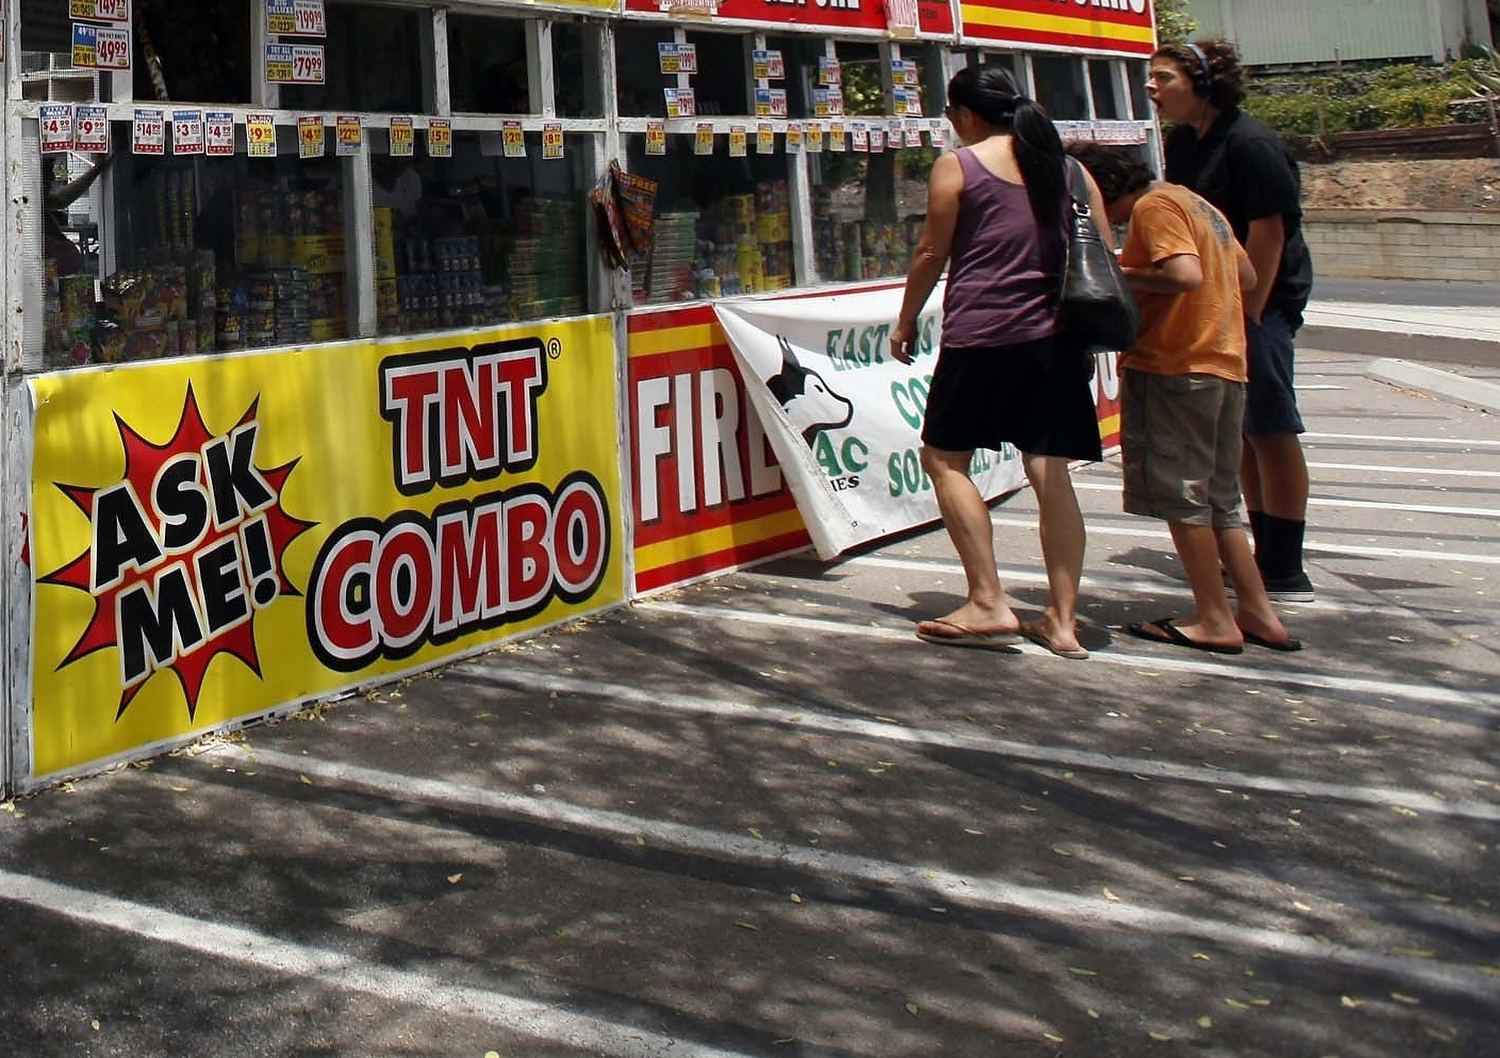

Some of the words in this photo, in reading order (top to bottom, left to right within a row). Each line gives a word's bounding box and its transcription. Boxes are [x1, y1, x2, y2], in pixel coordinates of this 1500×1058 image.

[384, 347, 545, 486] TNT
[825, 322, 891, 373] EAST
[91, 422, 279, 596] ASK
[312, 480, 606, 662] COMBO
[117, 516, 282, 689] ME!
